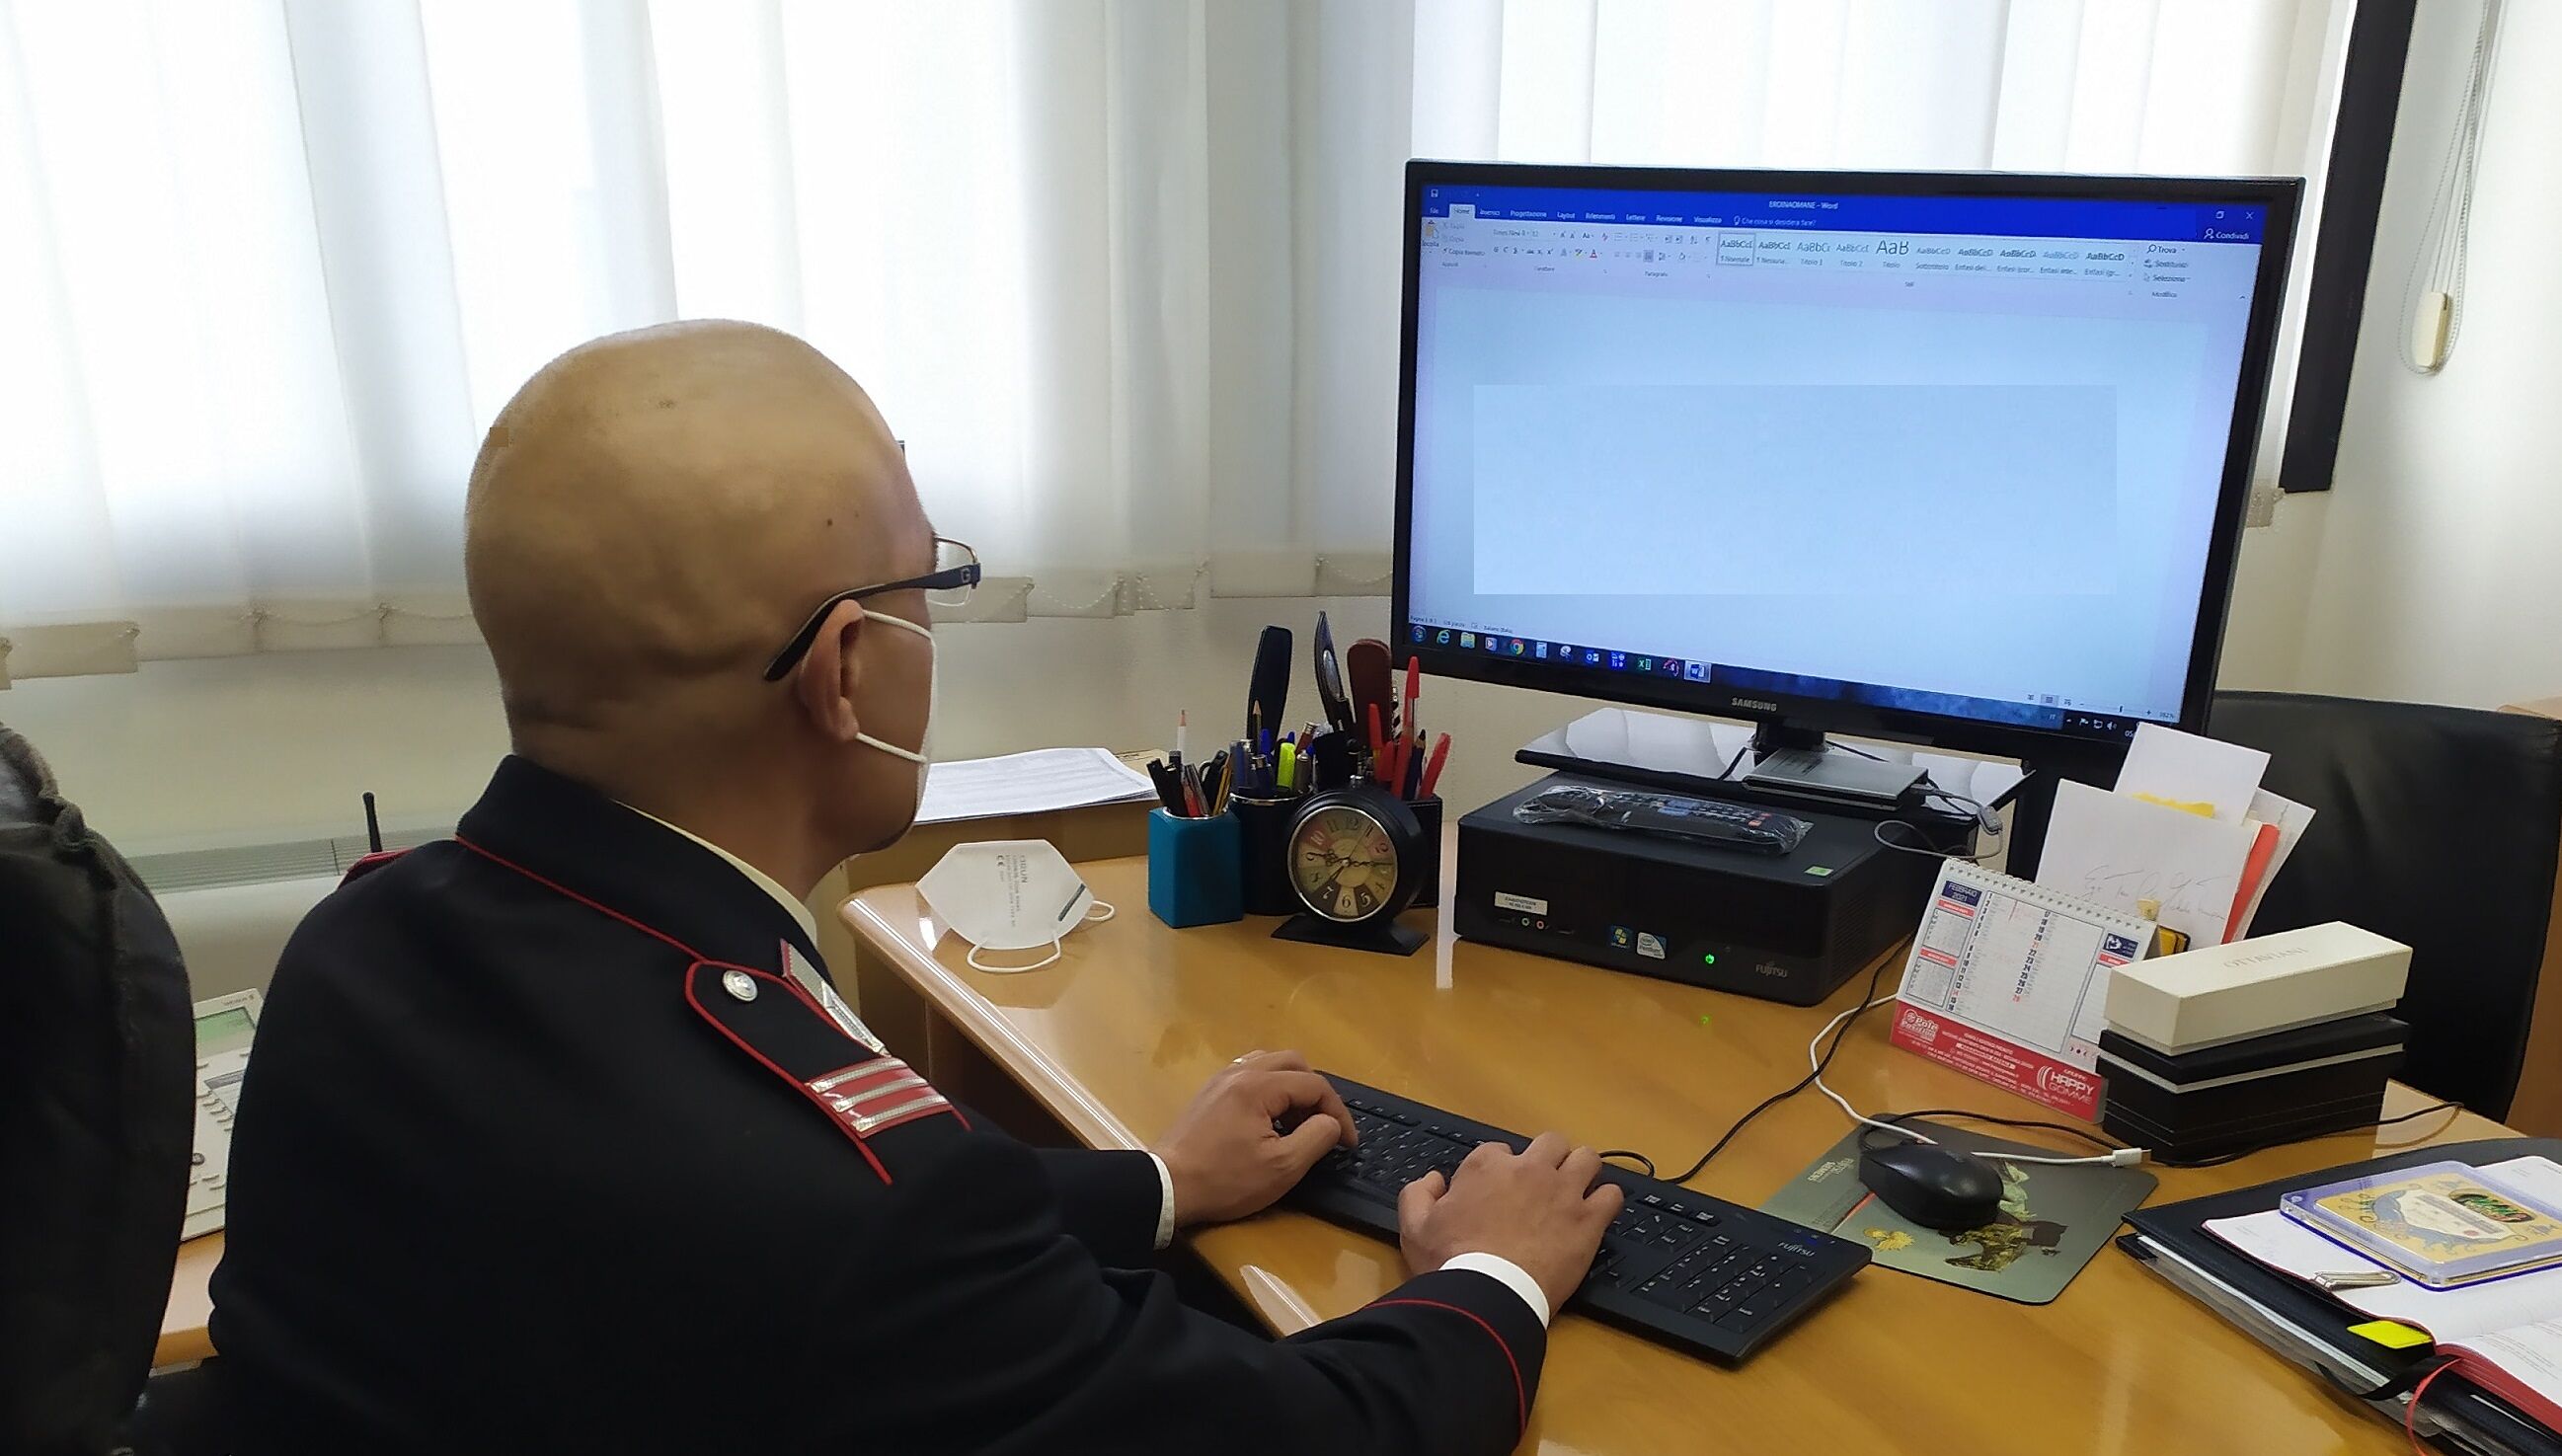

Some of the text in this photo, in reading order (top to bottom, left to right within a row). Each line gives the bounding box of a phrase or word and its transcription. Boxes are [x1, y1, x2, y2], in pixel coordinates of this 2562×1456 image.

[2157, 245, 2177, 254] Trova
[1731, 697, 1777, 712] SAMSUNG
[1948, 882, 1978, 898] FEBBRAIO
[1951, 892, 1968, 902] 2021
[1342, 894, 1352, 908] 6
[1755, 963, 1788, 978] FUJITSU
[2051, 1072, 2094, 1095] HAPPY
[2049, 1082, 2092, 1106] GOMME
[1778, 1241, 1815, 1257] FUJITSU
